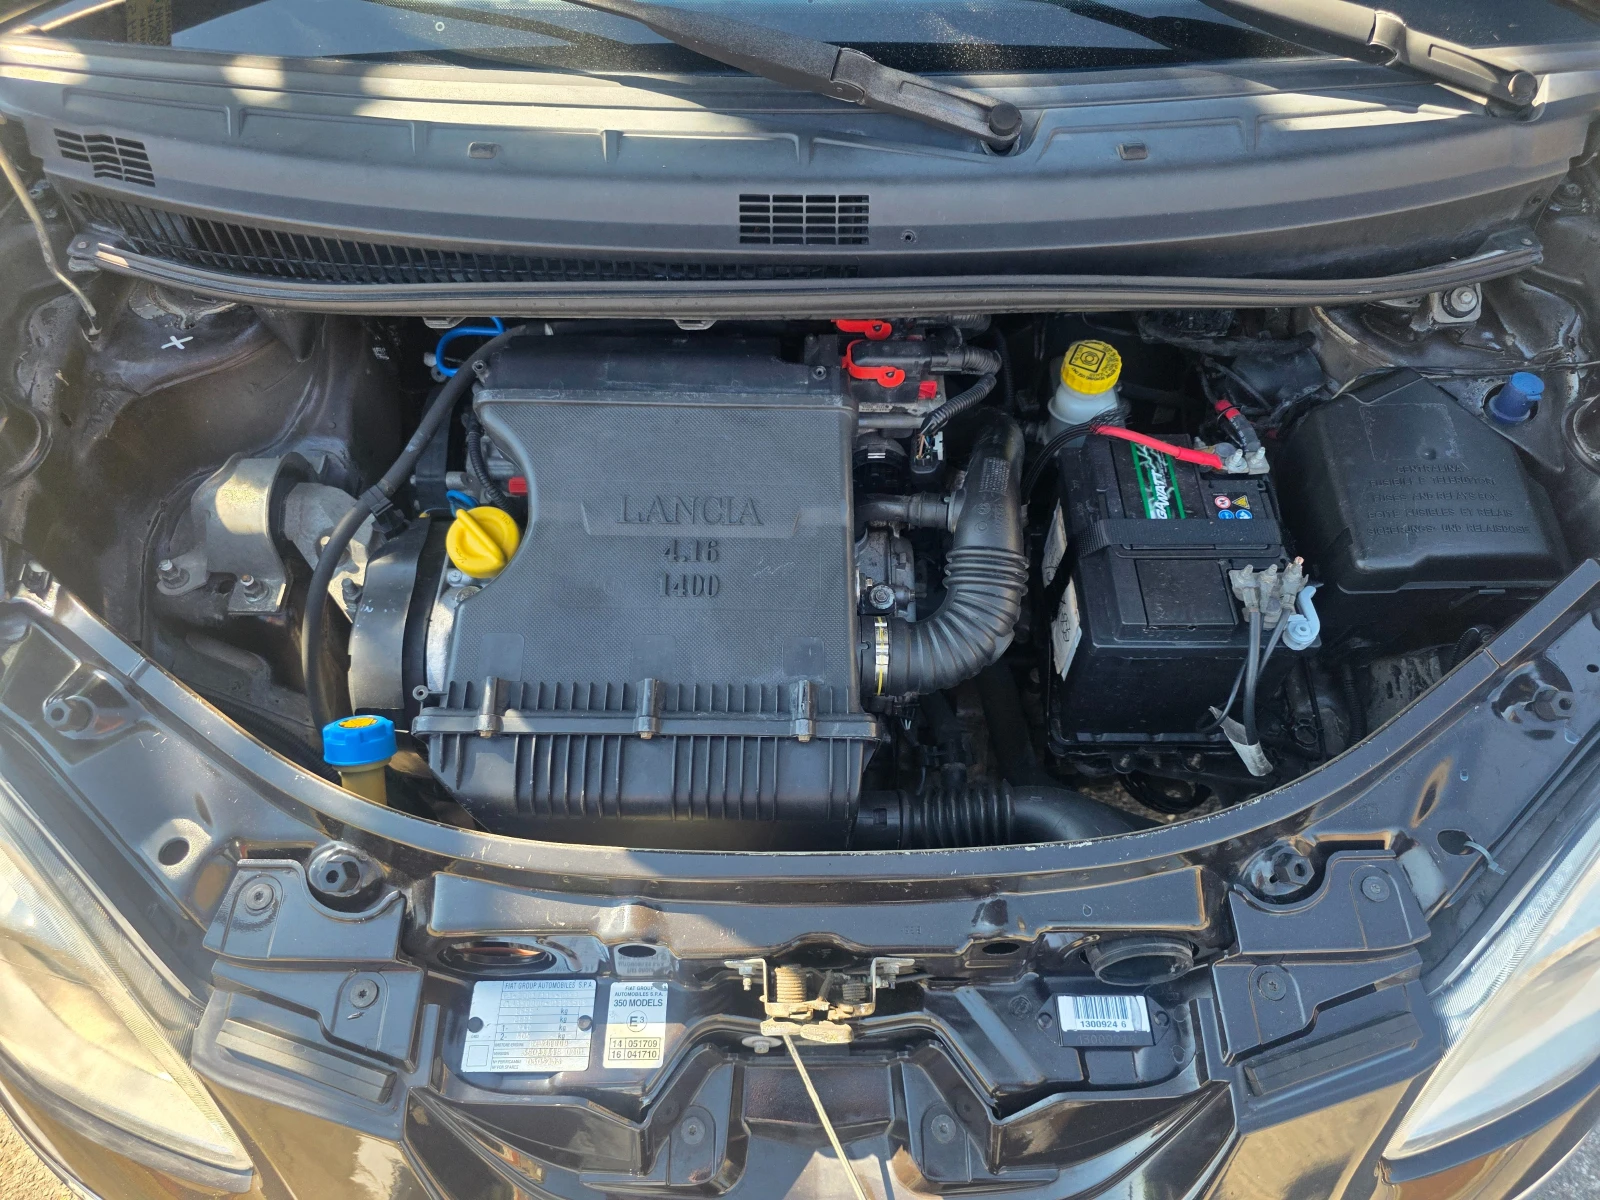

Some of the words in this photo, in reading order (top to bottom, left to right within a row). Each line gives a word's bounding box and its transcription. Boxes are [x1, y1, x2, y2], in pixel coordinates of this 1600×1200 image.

[1396, 464, 1463, 474] CENTRALINA
[1152, 469, 1169, 519] GAWATT
[1371, 494, 1407, 504] FUSES
[1412, 492, 1433, 501] AND
[1436, 491, 1476, 500] RELAYS
[1477, 492, 1499, 501] BOX
[616, 494, 764, 526] LANCIA
[1460, 507, 1473, 515] ET
[1477, 508, 1513, 517] RELAIS
[1441, 523, 1462, 532] UND
[1466, 524, 1531, 534] RELAISDOSE
[663, 539, 719, 564] 4.16
[658, 572, 720, 598] 1400
[629, 998, 663, 1007] MODELS
[560, 1016, 567, 1024] kg
[558, 1024, 566, 1032] kg
[558, 1032, 566, 1040] kg
[628, 1040, 658, 1048] 051709
